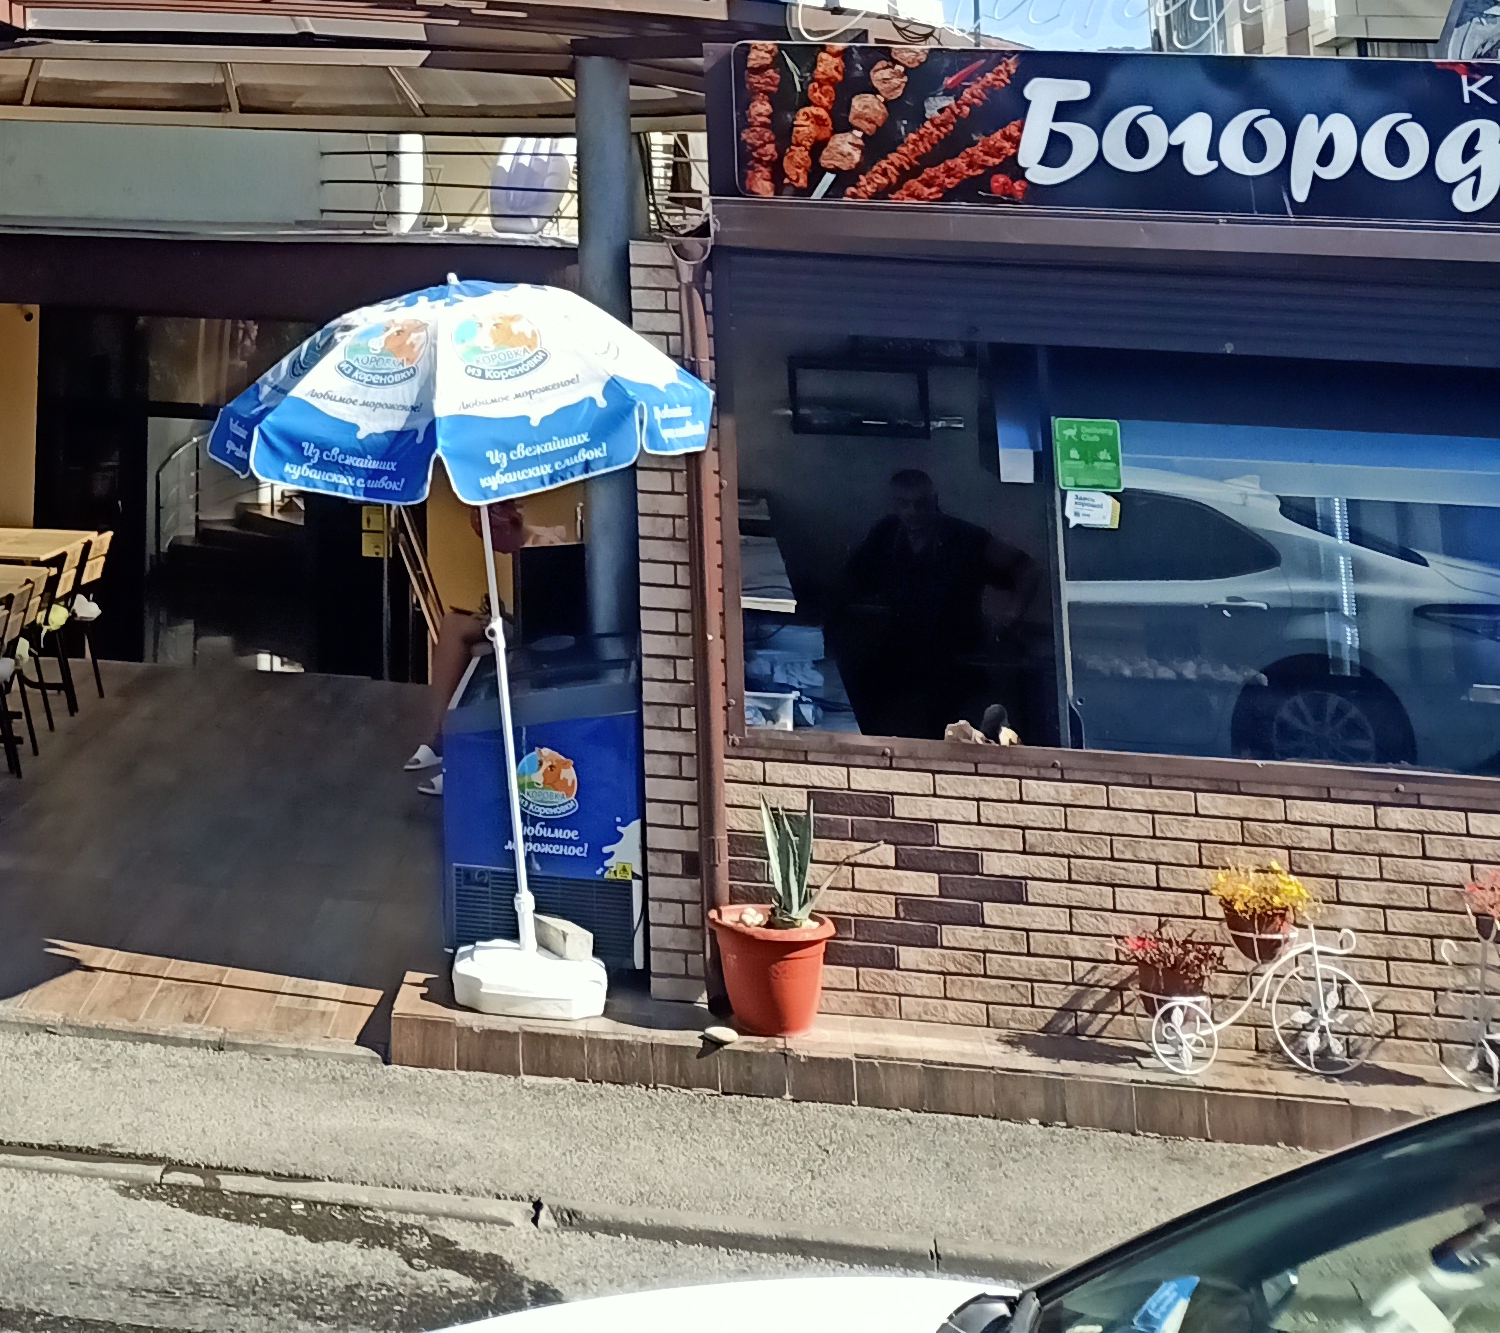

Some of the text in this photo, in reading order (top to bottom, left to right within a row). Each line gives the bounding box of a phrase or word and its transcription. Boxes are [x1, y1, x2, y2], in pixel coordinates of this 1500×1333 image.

[474, 347, 531, 365] КОРОВКА
[513, 374, 580, 399] мороженое!
[301, 442, 397, 471] Из свежайших
[486, 432, 590, 468] Из свежайших
[480, 442, 608, 490] кубанских сливок!
[521, 822, 580, 840] юбимое
